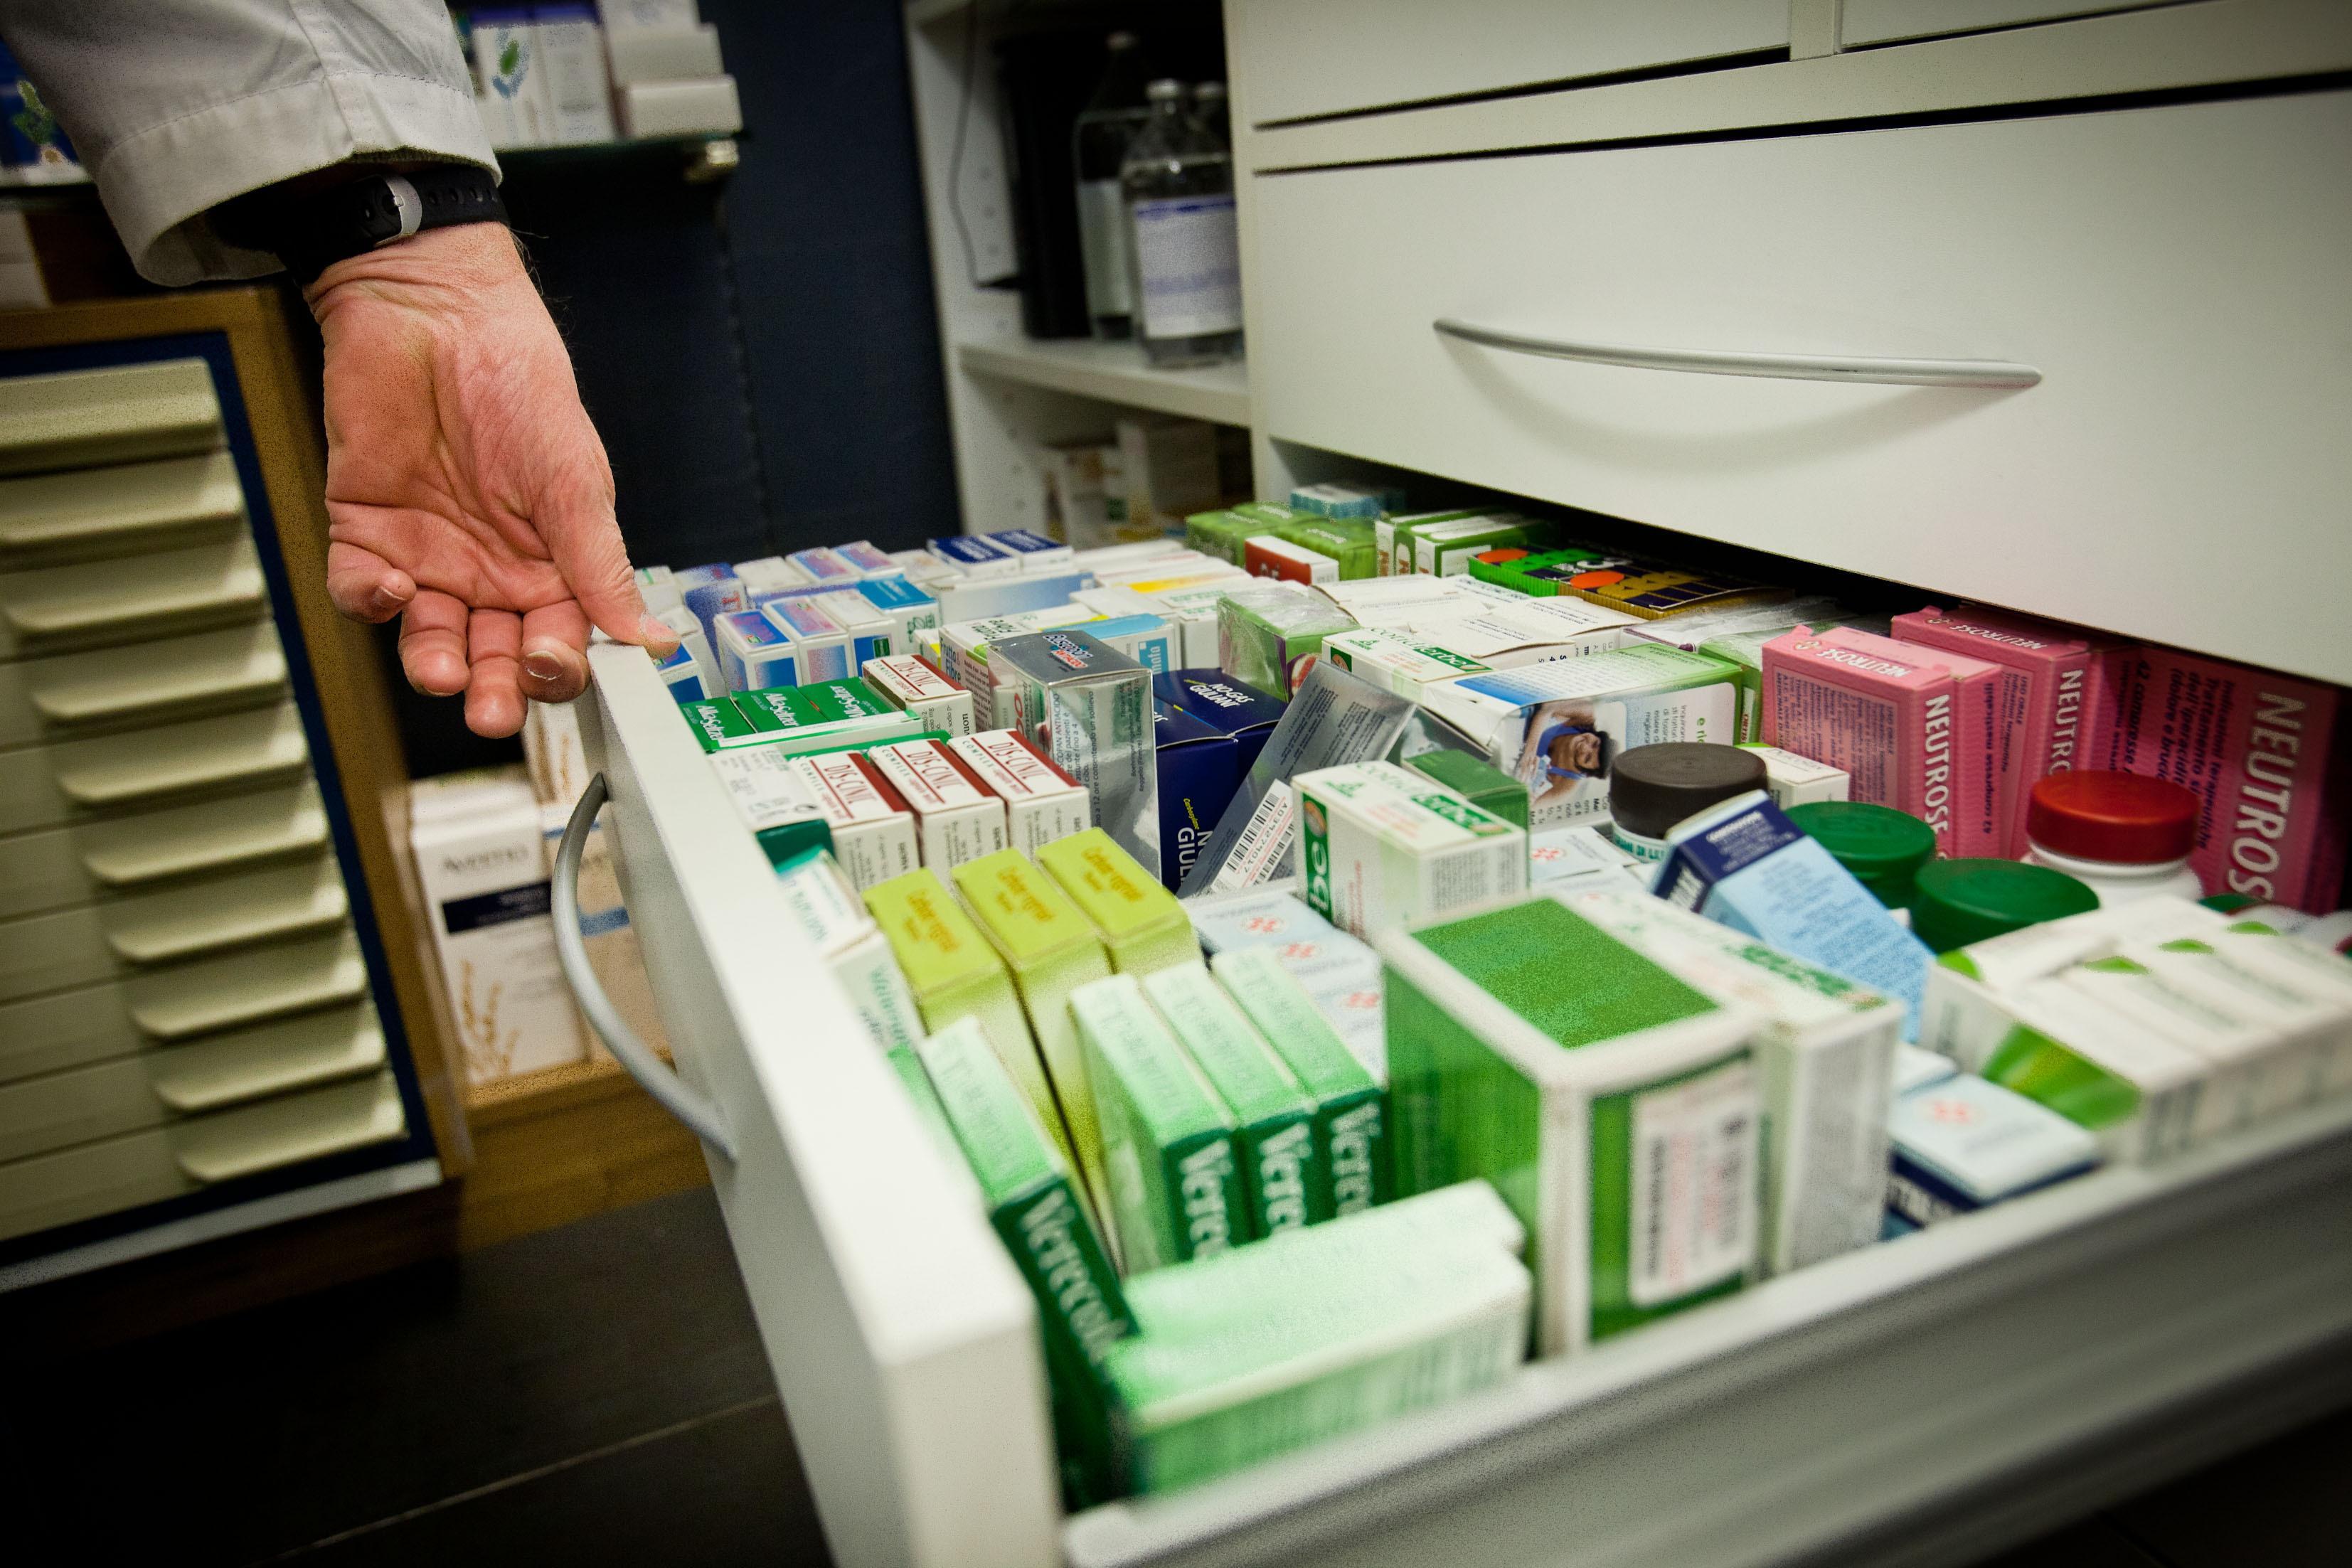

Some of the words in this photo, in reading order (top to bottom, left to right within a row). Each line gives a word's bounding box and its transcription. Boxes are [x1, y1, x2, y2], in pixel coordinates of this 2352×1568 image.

[1949, 624, 2048, 650] NEUTROSE
[1815, 648, 1912, 678] NEUTROSE
[1053, 693, 1062, 735] ANTIACIDO
[1063, 719, 1073, 748] pazienti
[1090, 732, 1099, 779] consentendo
[2228, 692, 2306, 901] NEUTROS
